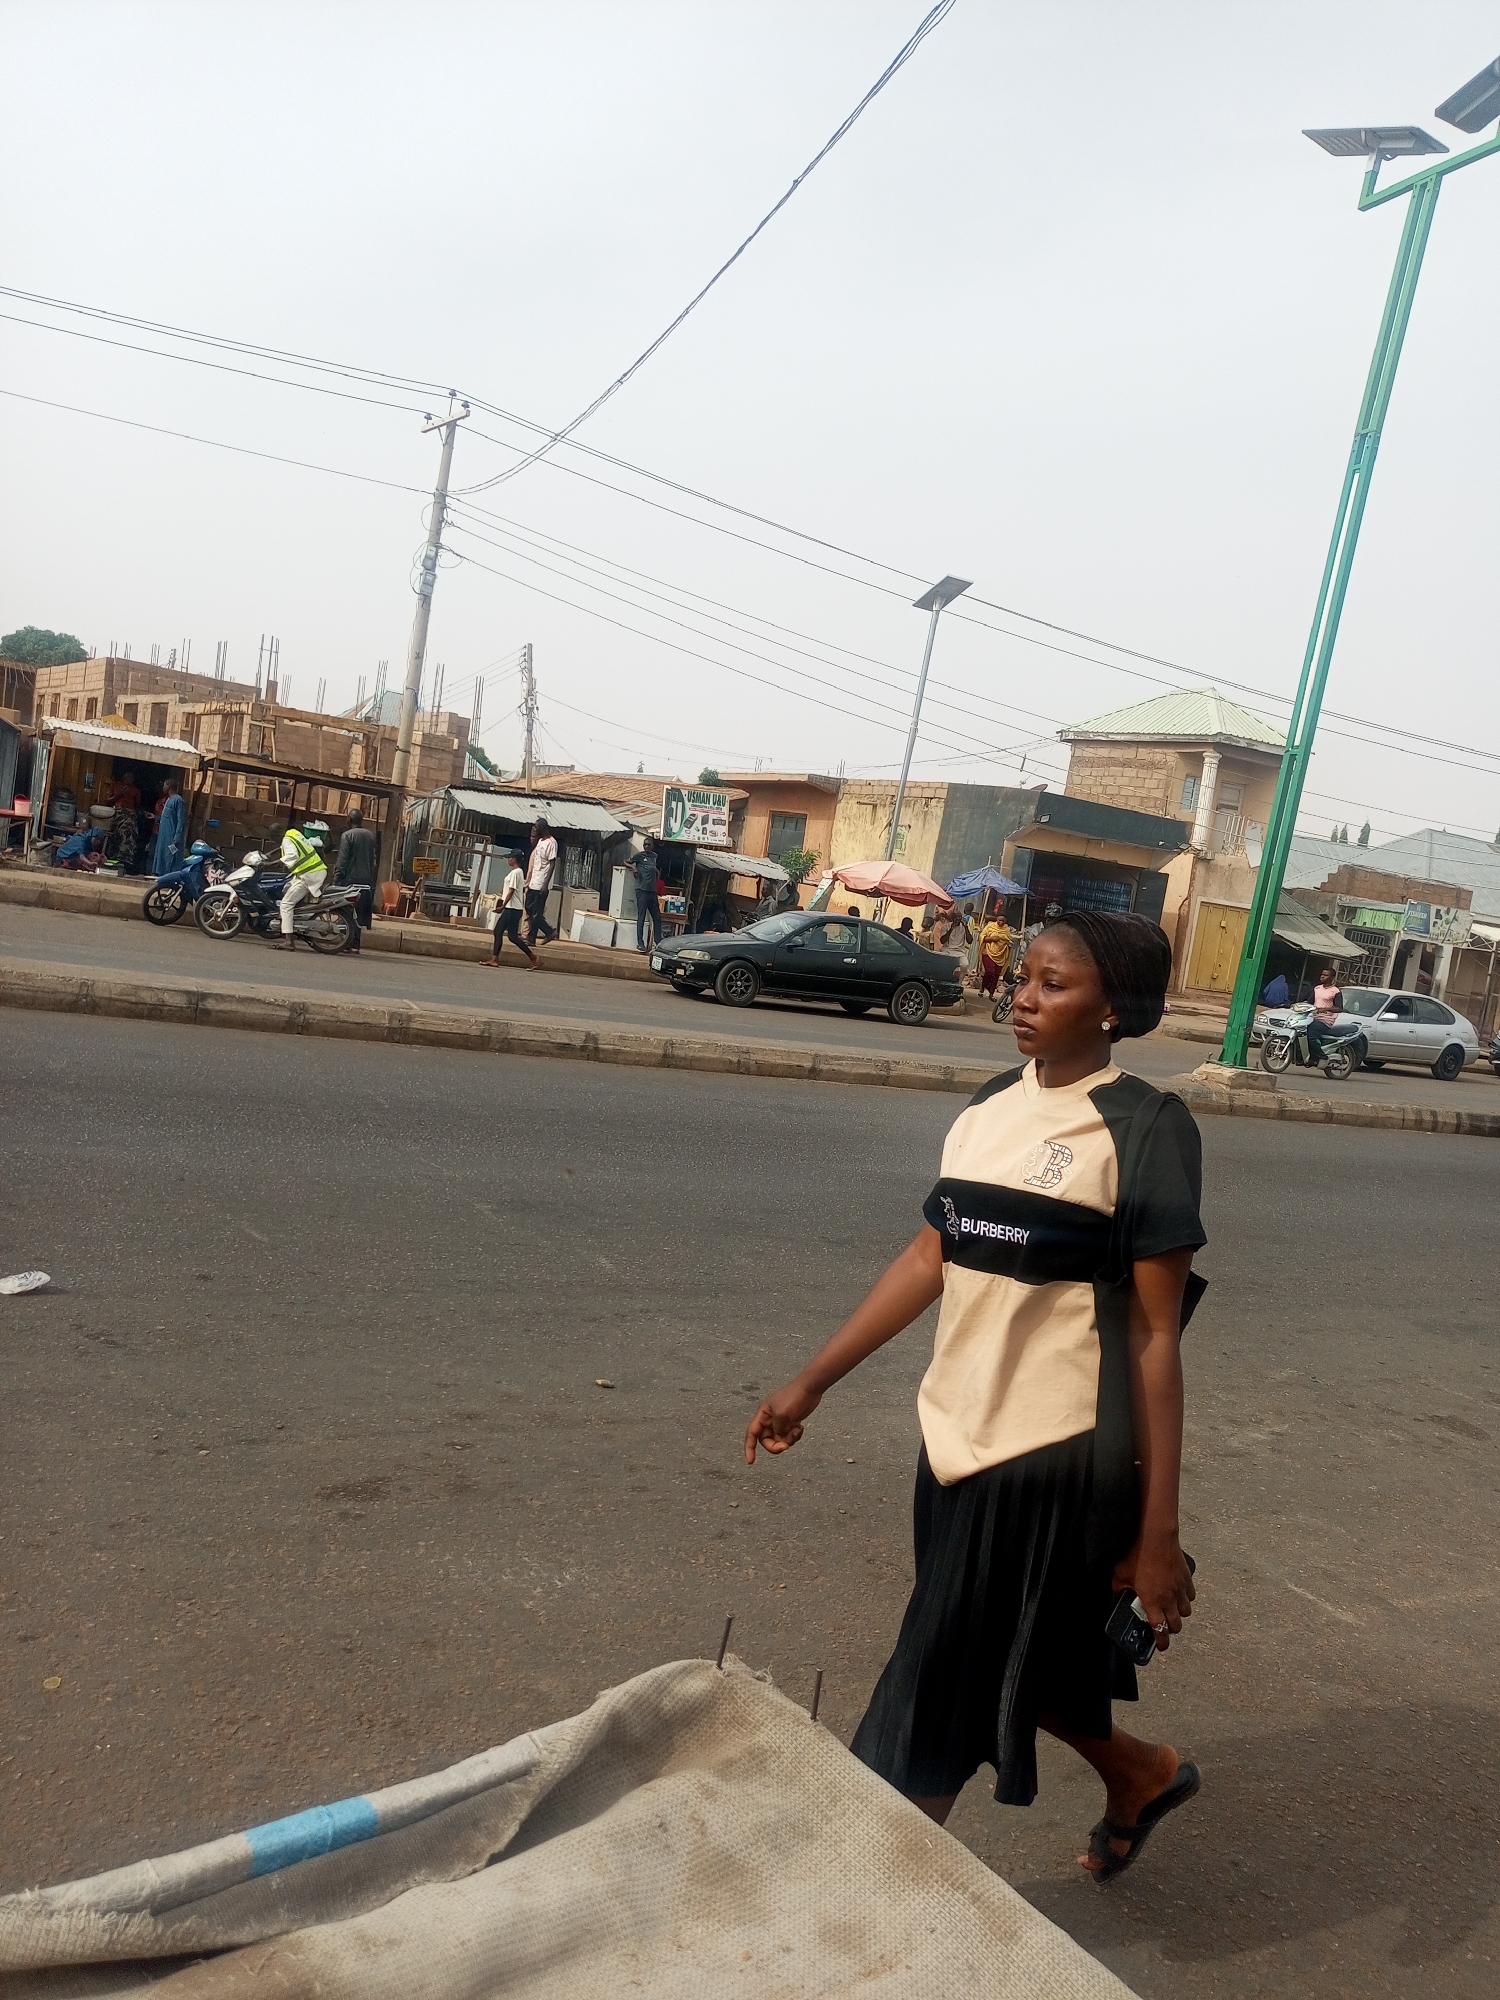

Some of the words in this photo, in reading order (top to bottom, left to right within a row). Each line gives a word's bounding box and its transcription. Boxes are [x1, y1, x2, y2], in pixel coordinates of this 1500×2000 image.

[688, 791, 711, 805] USMAN
[712, 794, 726, 806] U&U
[961, 1218, 1030, 1245] BURBERRY
